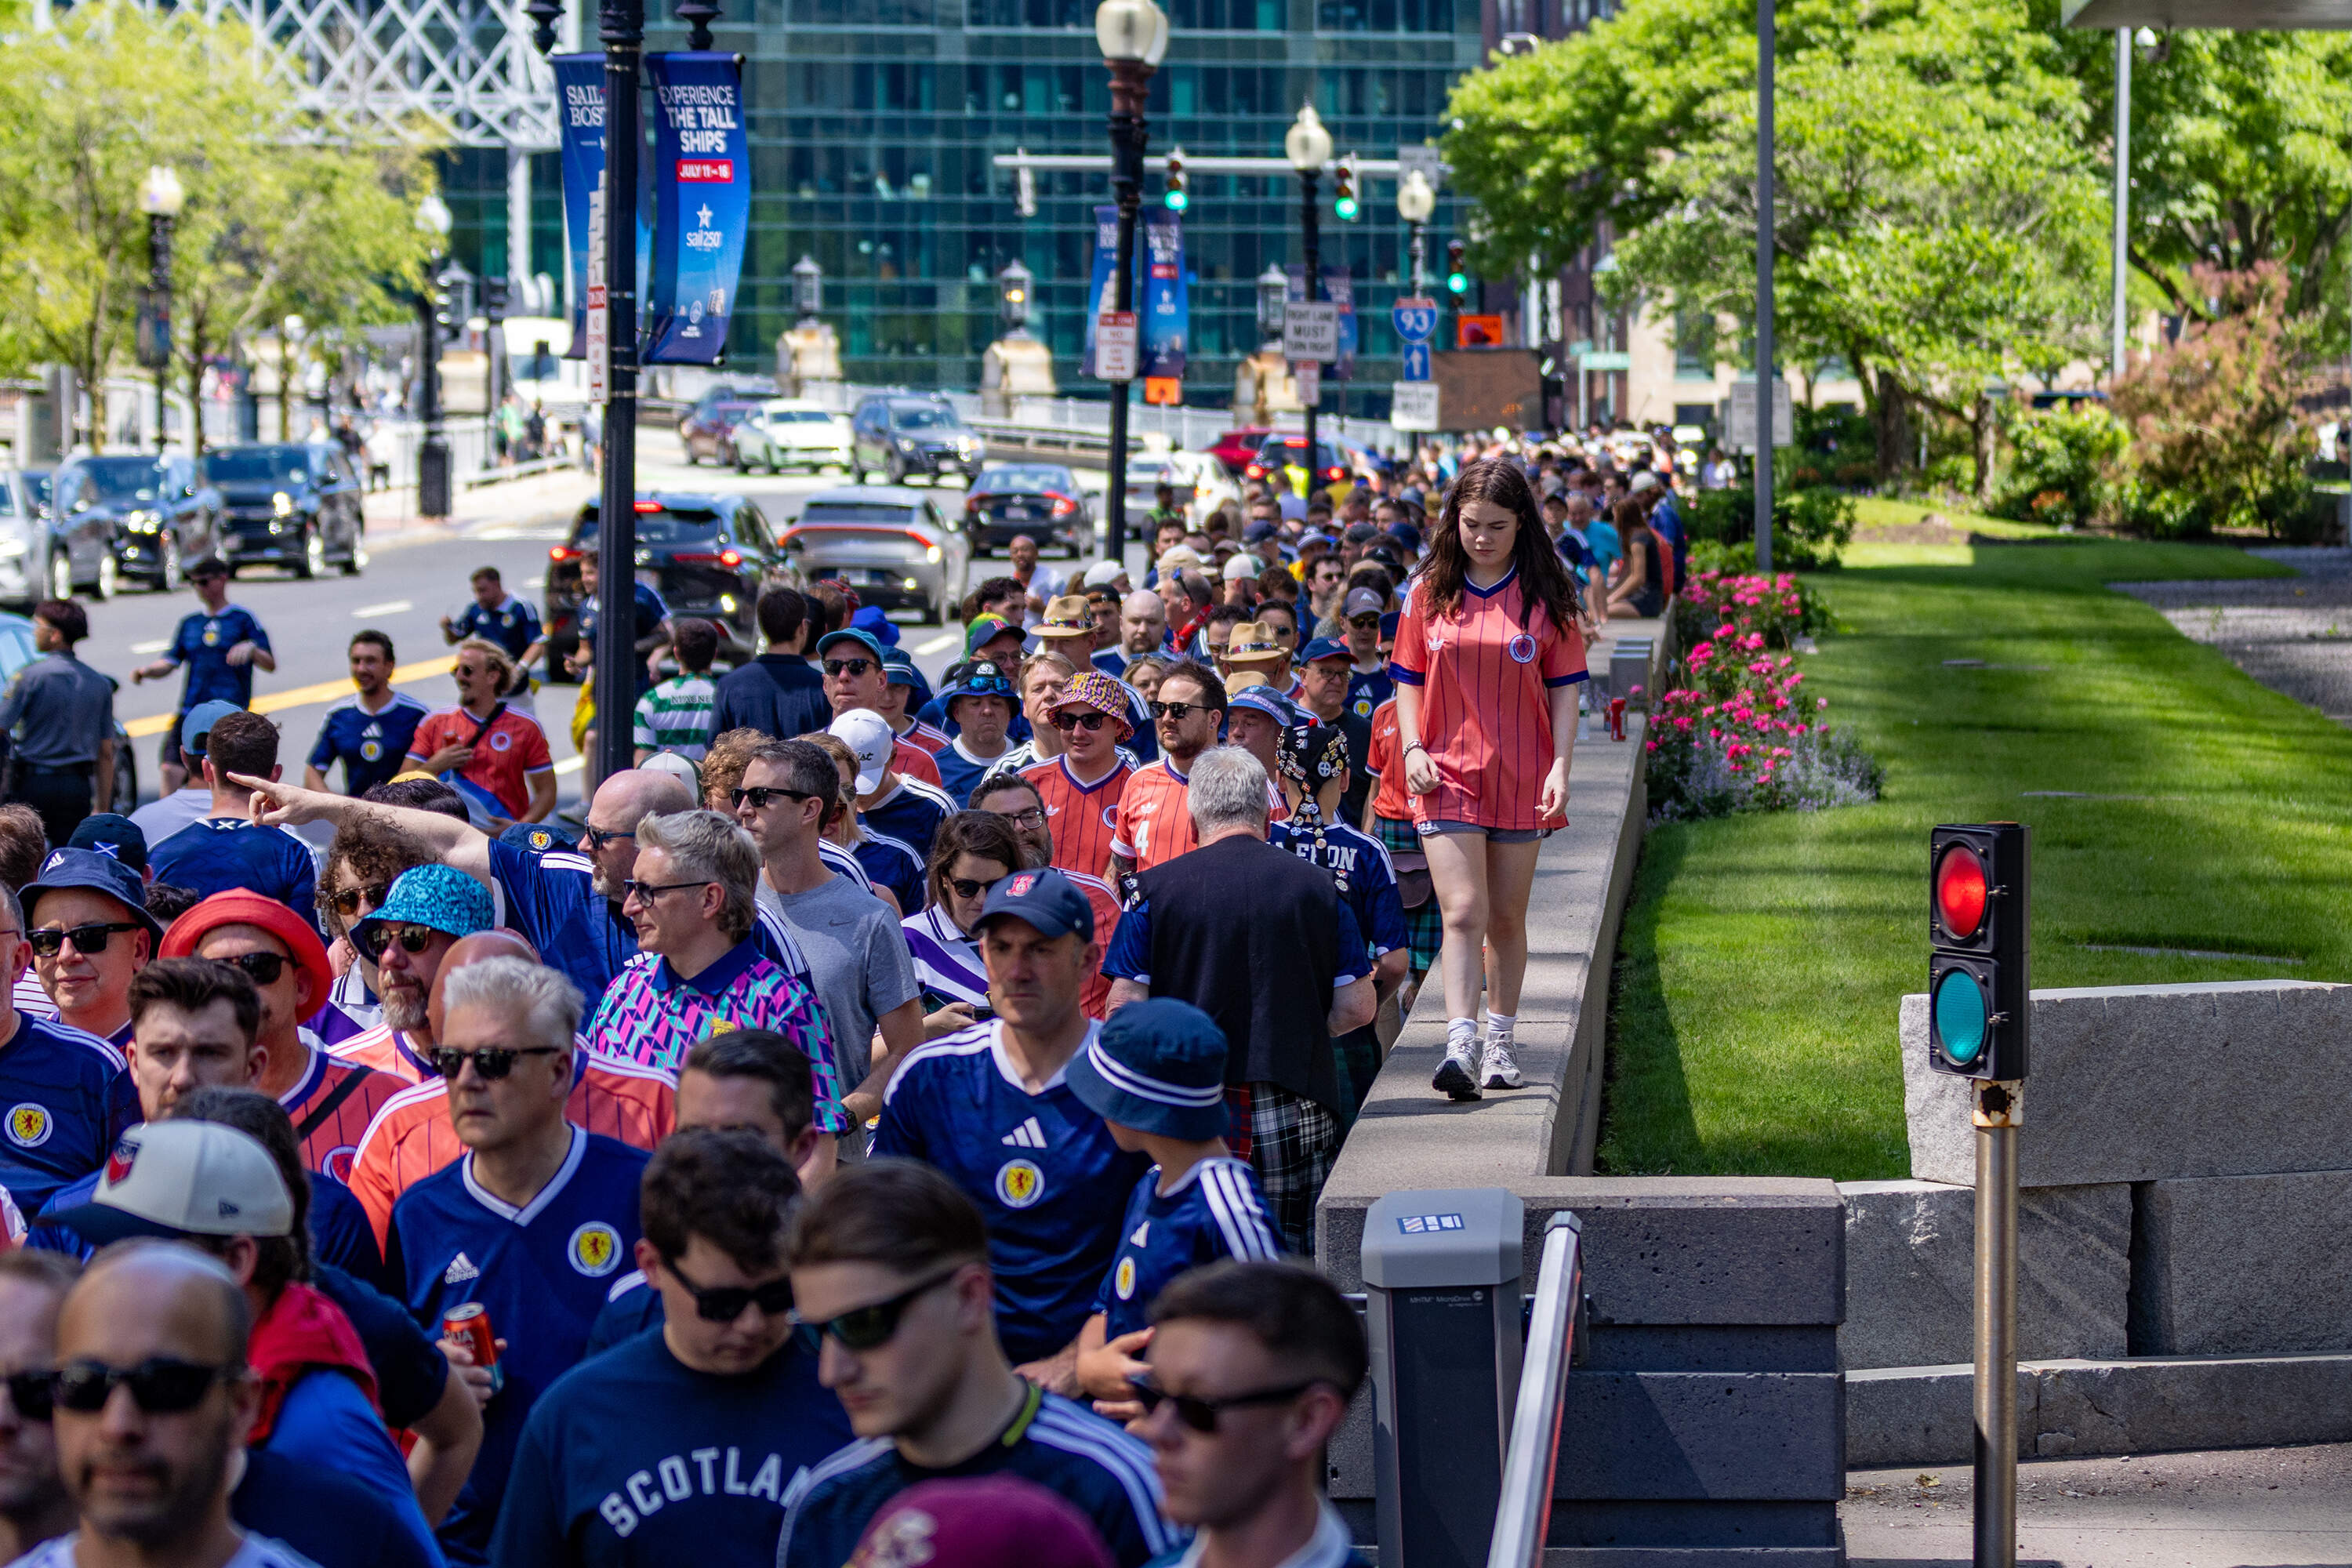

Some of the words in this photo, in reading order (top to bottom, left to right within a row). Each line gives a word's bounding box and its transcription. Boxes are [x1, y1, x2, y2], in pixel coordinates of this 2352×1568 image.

[566, 85, 602, 105] SAIL
[659, 85, 735, 106] EXPERIENCE
[666, 107, 696, 129] THE
[697, 107, 738, 129] TALL
[680, 164, 701, 178] JULY
[1287, 310, 1309, 320] RIGHT
[1312, 310, 1333, 322] LANE
[1400, 311, 1429, 332] 93
[1294, 325, 1327, 339] MUST
[1287, 340, 1306, 351] TURN
[1309, 342, 1331, 352] RIGHT
[1134, 820, 1149, 857] 4
